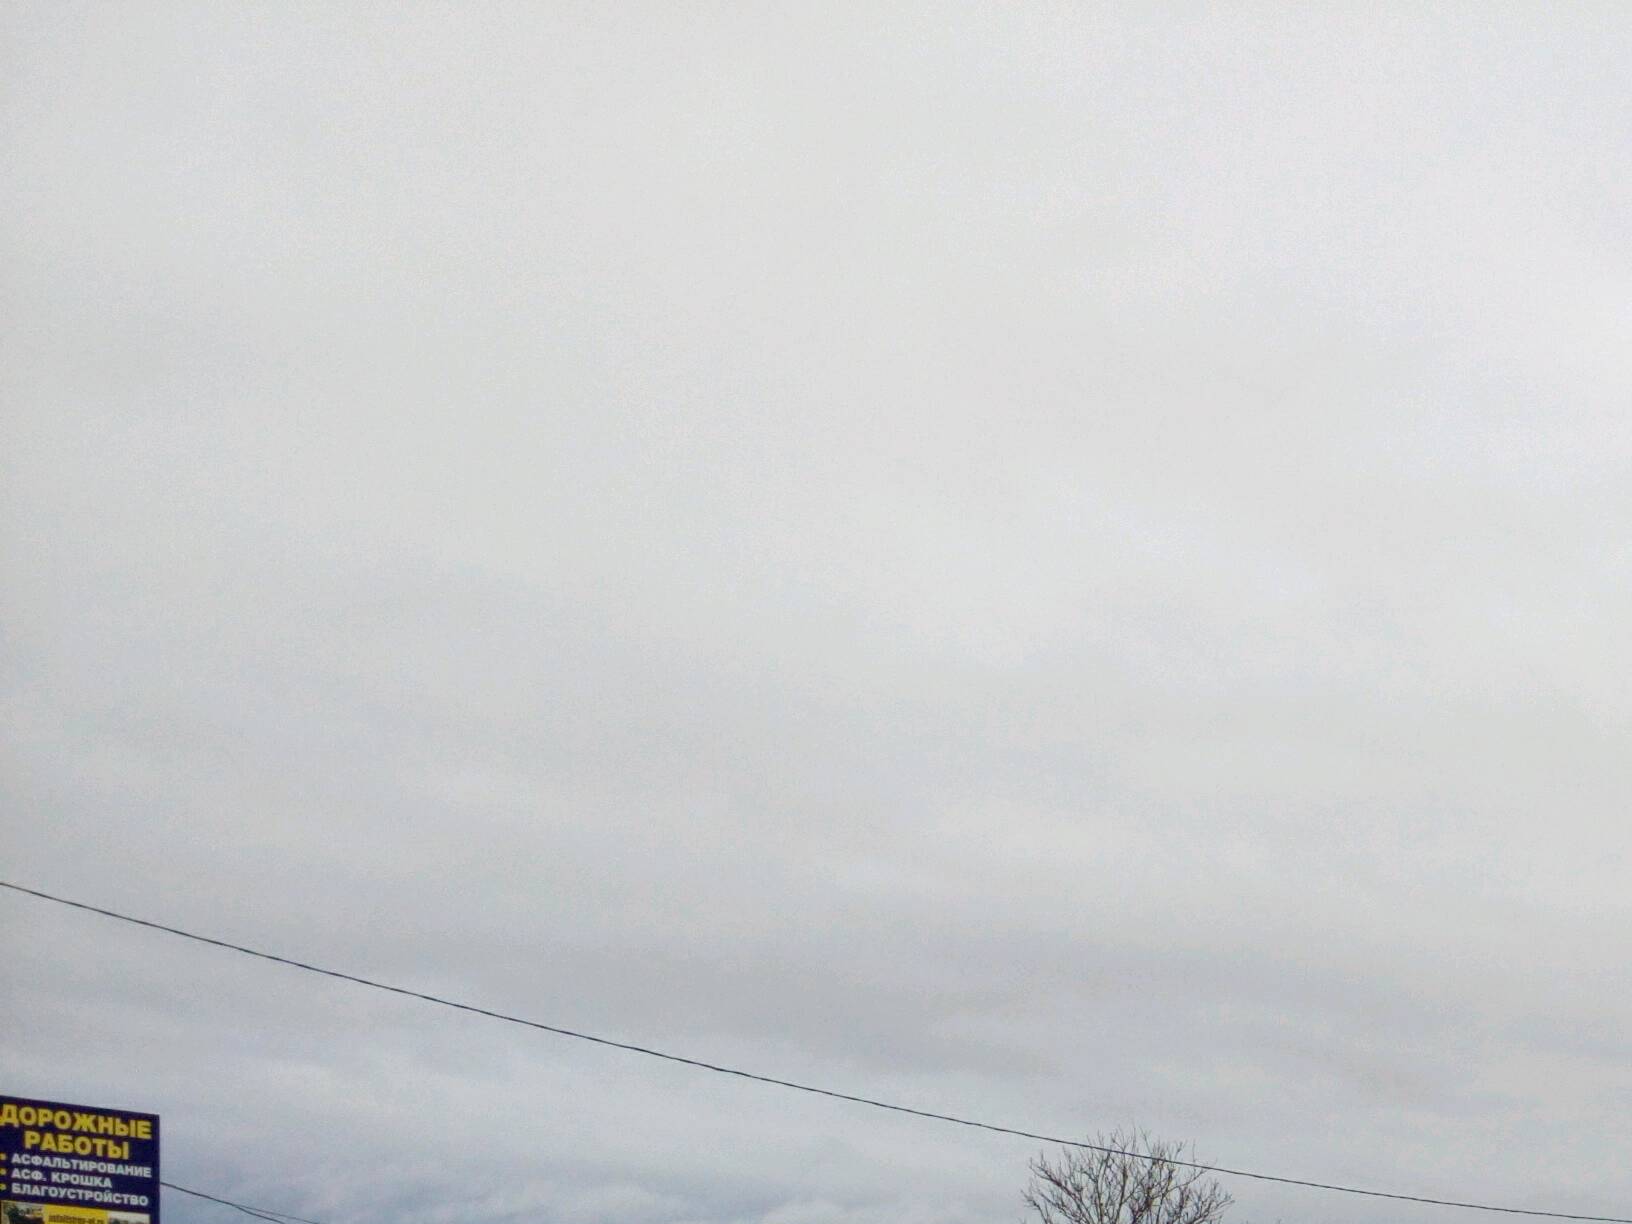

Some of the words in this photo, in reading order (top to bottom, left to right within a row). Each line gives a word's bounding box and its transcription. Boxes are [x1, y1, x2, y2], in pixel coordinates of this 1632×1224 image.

[0, 1104, 152, 1139] ДОРОЖНЫЕ
[24, 1131, 129, 1160] РАБОТЫ
[11, 1153, 152, 1178] АСФАЛЬТИРОВАНИЕ
[11, 1168, 47, 1182] АСФ.
[51, 1172, 113, 1189] КРОШКА
[11, 1183, 149, 1207] БЛАГОУСТРОЙСТВО
